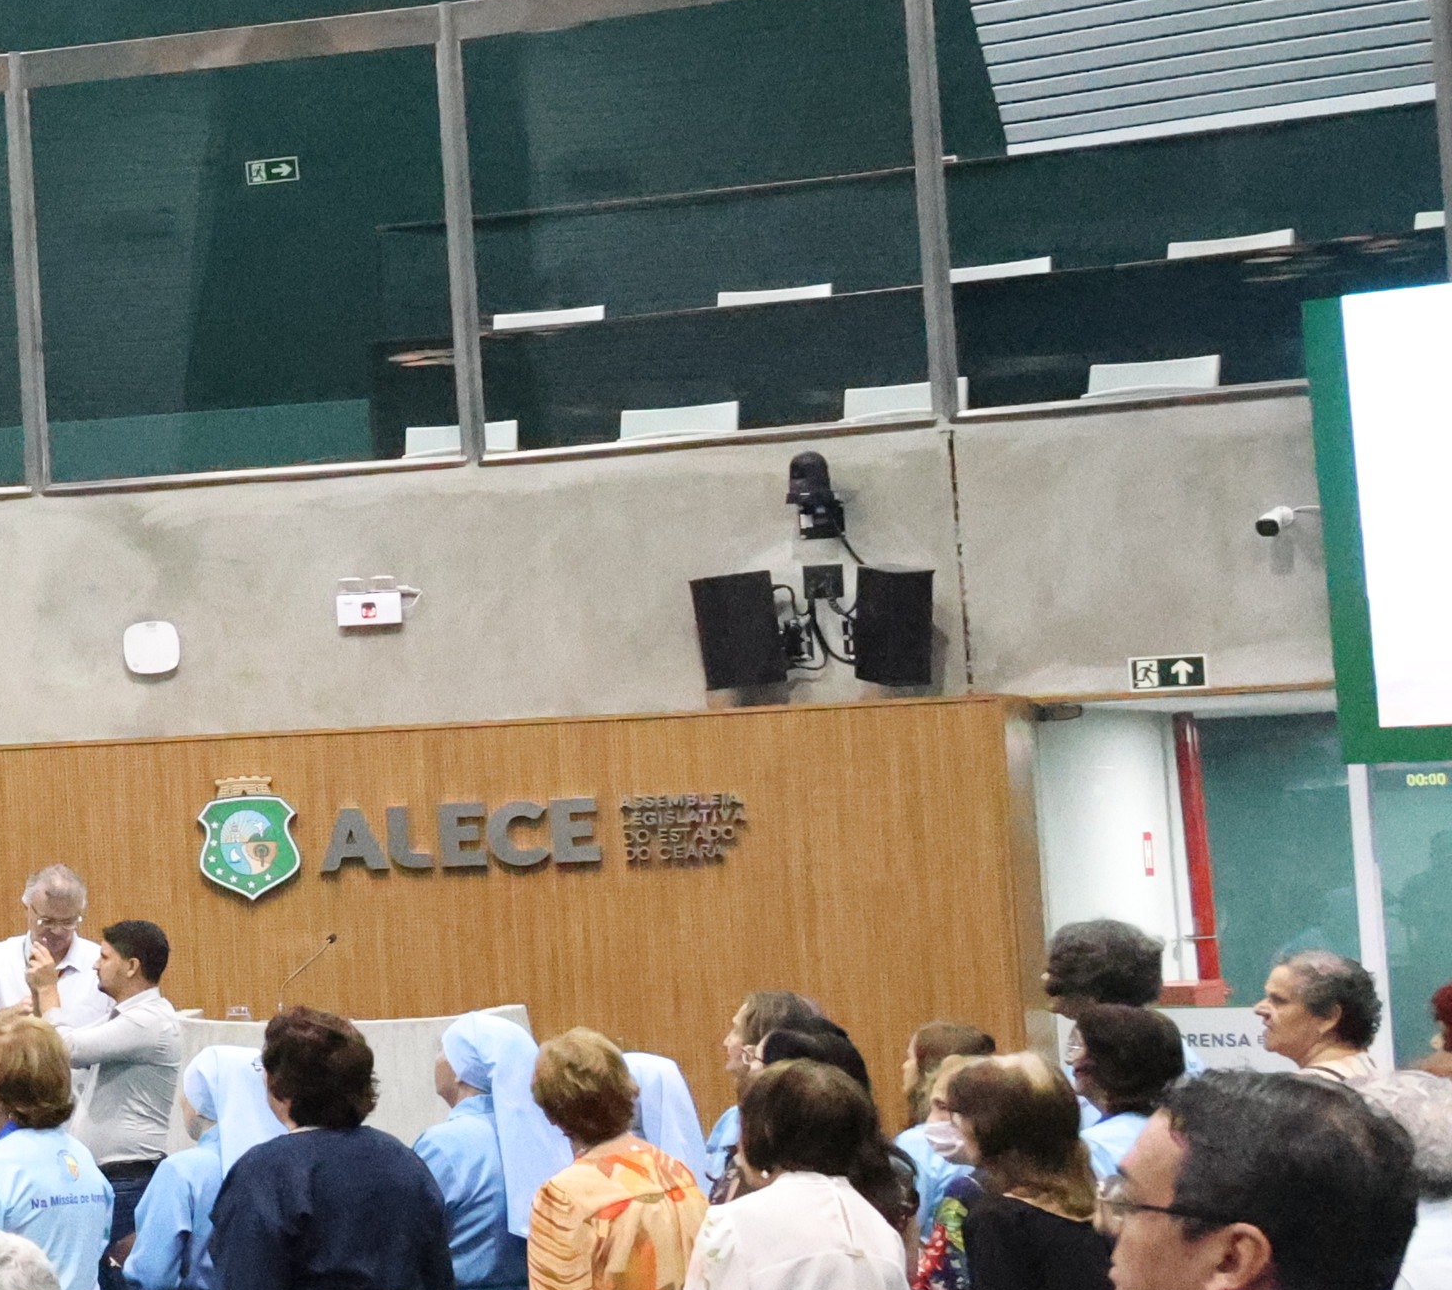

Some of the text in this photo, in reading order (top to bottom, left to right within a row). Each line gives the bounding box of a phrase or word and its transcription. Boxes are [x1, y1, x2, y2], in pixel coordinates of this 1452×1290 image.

[1406, 773, 1446, 786] 00:00
[620, 793, 744, 810] ASSEMBLEIA
[622, 808, 747, 827] LEGISLATIVA
[322, 796, 604, 873] ALECE
[624, 826, 735, 845] DO ESTADO
[626, 847, 650, 861] DO
[1182, 1033, 1251, 1047] RENSA
[31, 1198, 48, 1209] Na
